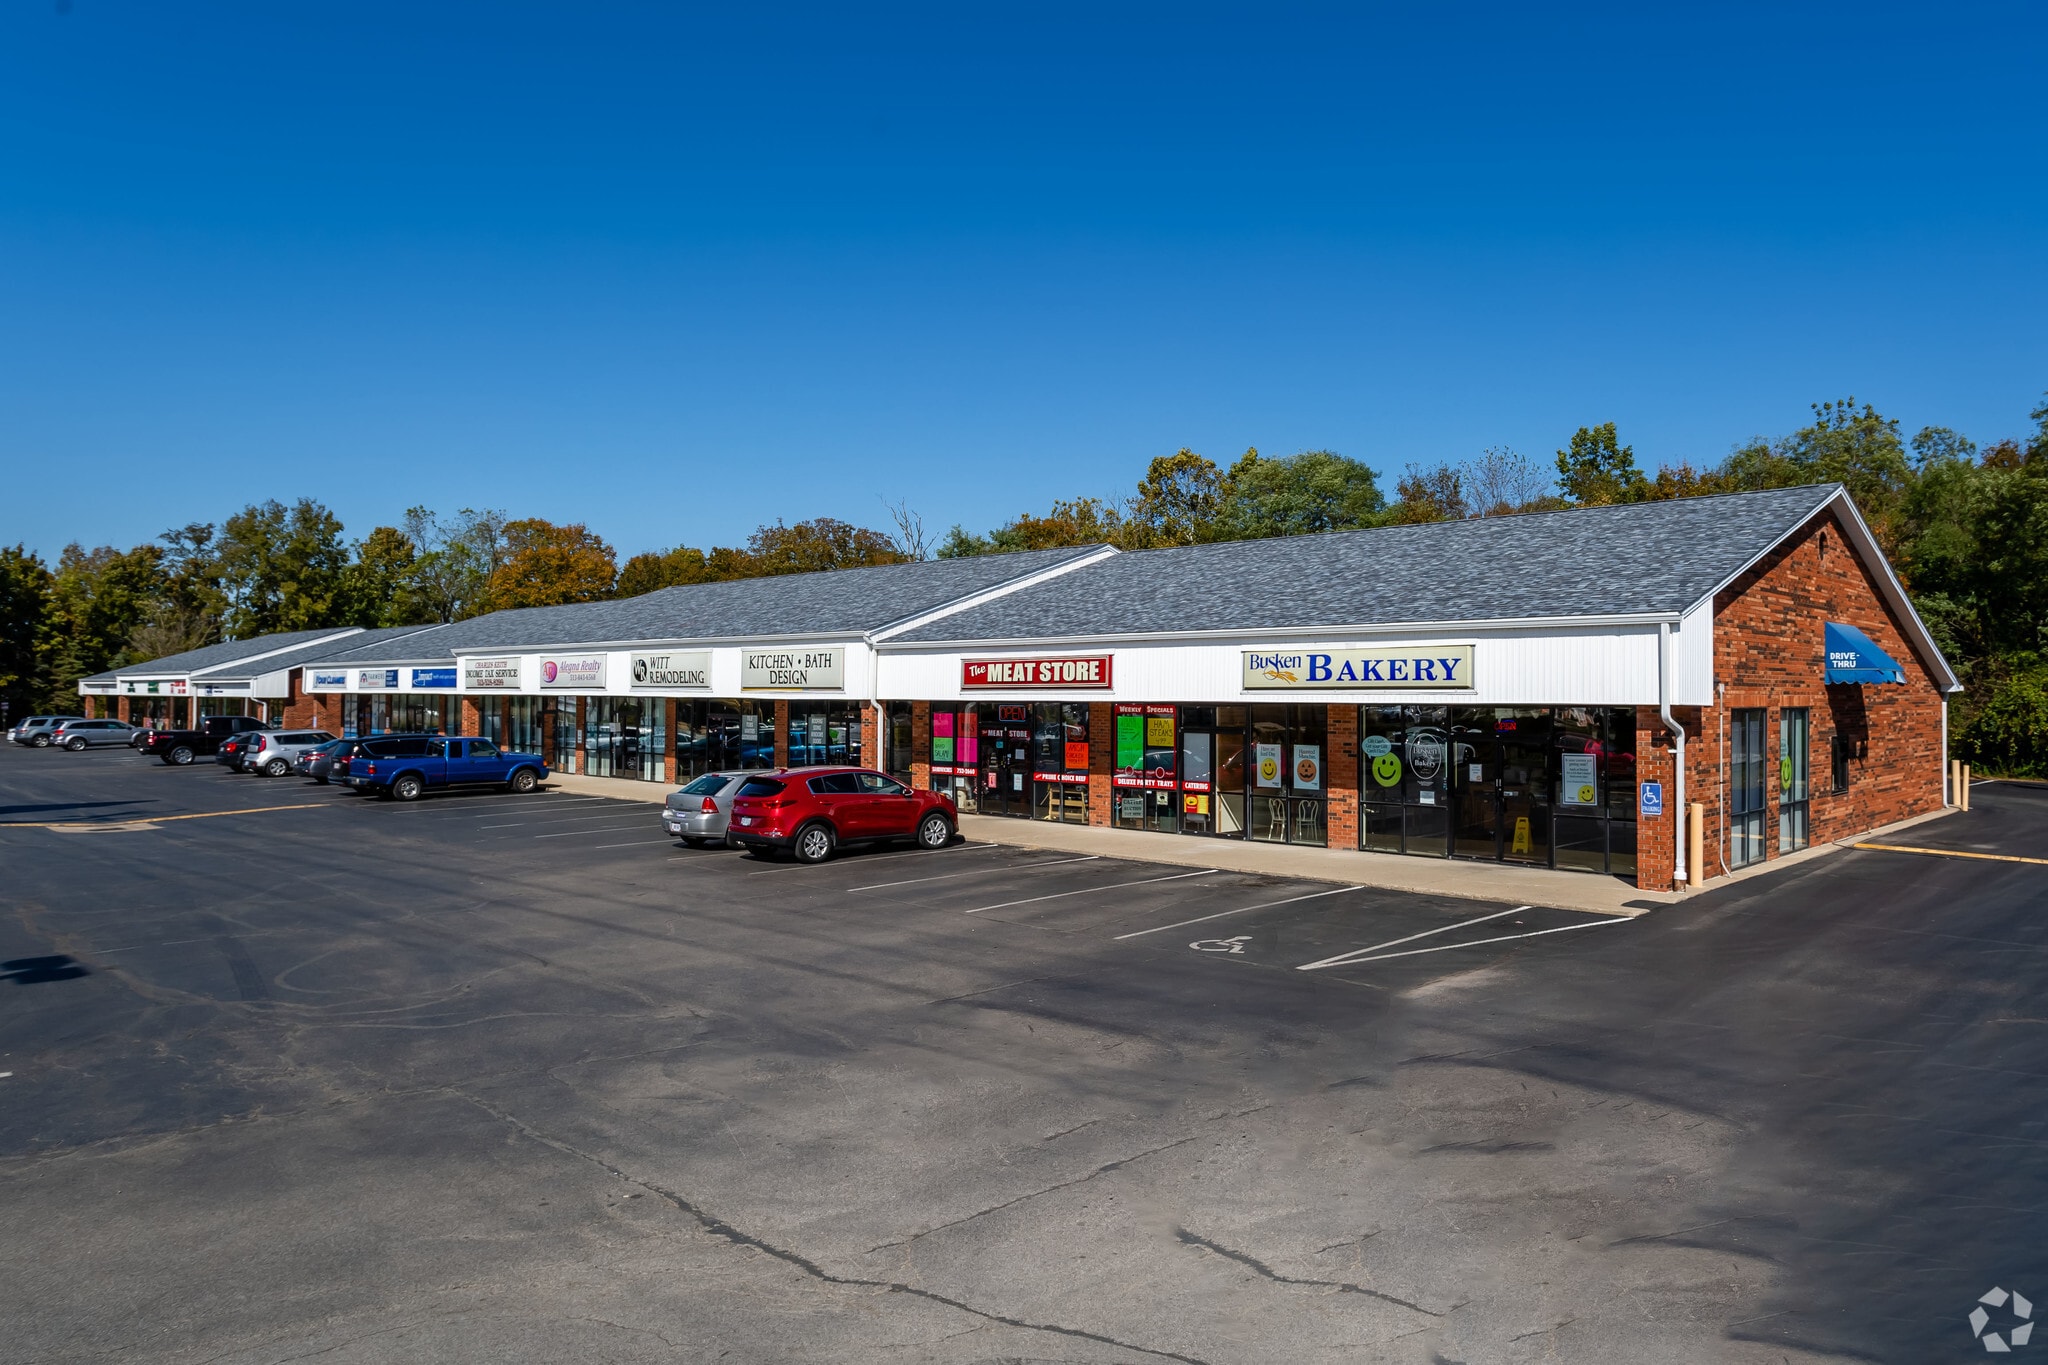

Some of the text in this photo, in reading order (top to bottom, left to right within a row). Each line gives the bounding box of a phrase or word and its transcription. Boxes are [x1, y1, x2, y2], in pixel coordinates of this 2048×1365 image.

[749, 653, 832, 669] KITCHEN BATH
[1830, 652, 1860, 660] DRIVE-
[560, 660, 602, 674] Alegna Realty
[650, 656, 670, 669] WITT
[1250, 653, 1462, 682] Busken BAKERY
[1832, 660, 1856, 668] THRU
[465, 669, 485, 678] INCOME
[485, 669, 495, 678] TAX
[495, 668, 518, 677] SERVICE
[969, 661, 1100, 682] The MEAT STORE
[650, 671, 704, 684] REMODELING
[769, 670, 808, 685] DESIGN
[1000, 706, 1025, 720] OPEN
[1146, 705, 1174, 713] SPECIALS
[1494, 721, 1517, 730] OPEN
[987, 729, 1004, 737] MEAT
[1008, 730, 1028, 738] STORE
[1150, 728, 1173, 737] STEAKS
[1414, 759, 1435, 768] Bakery
